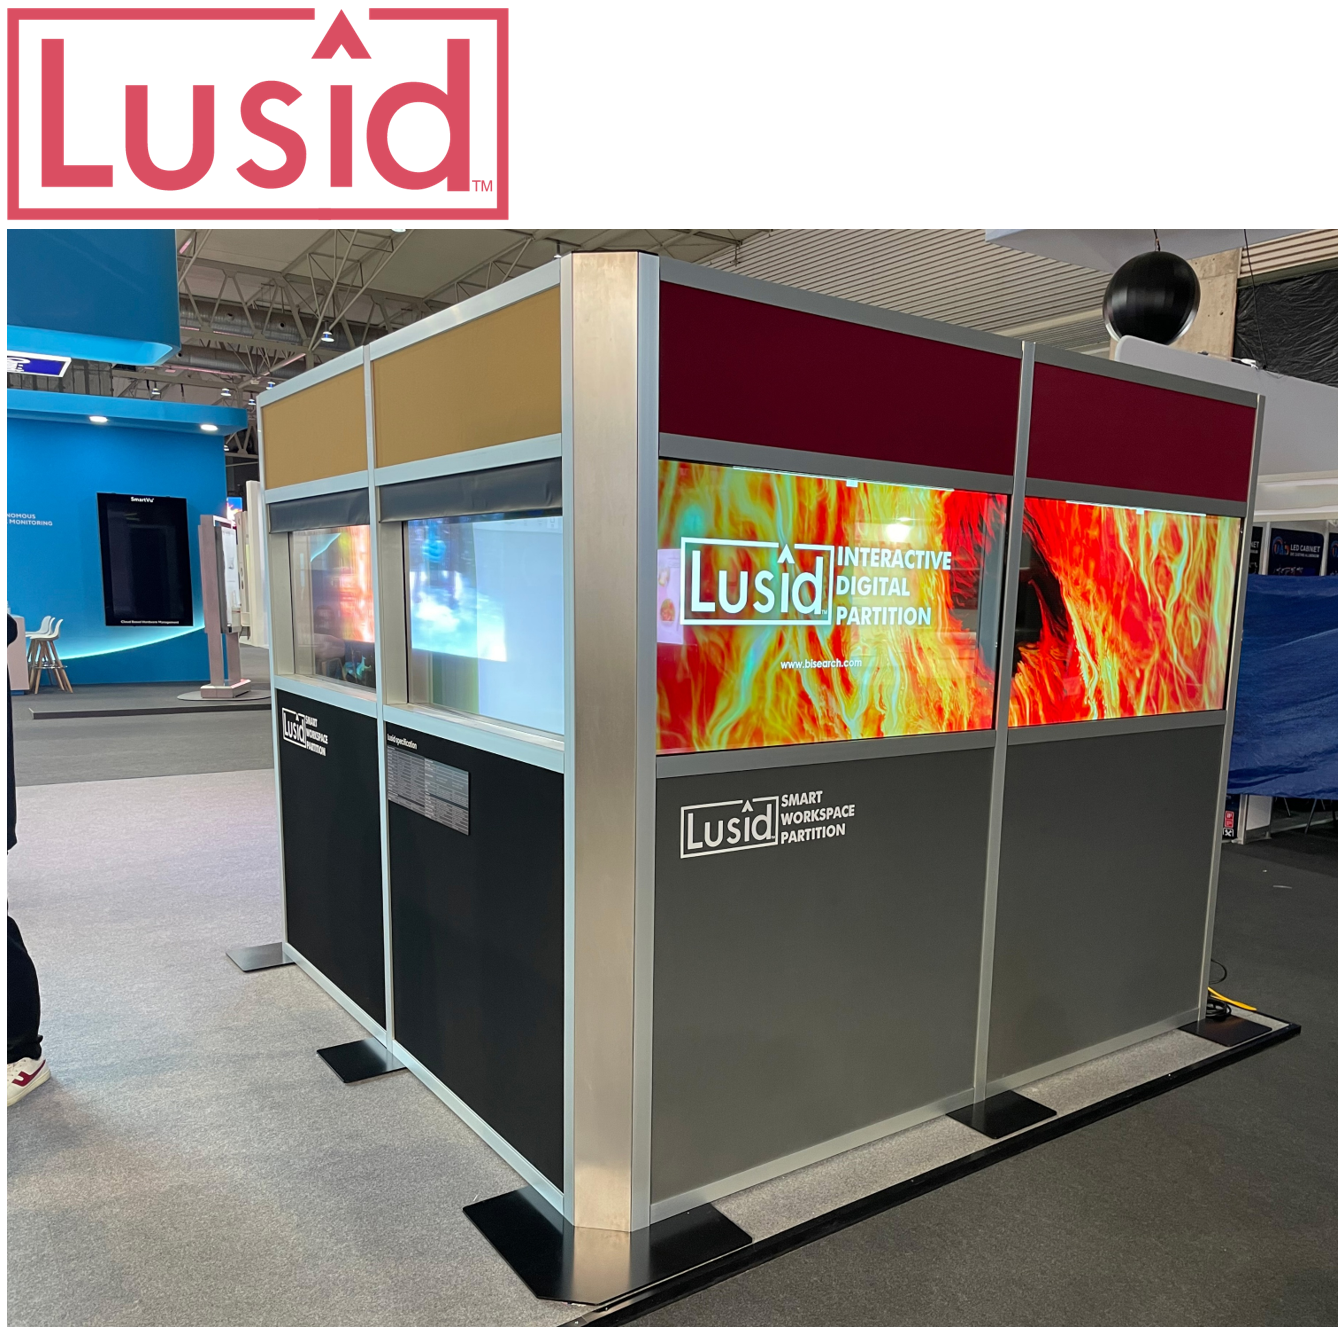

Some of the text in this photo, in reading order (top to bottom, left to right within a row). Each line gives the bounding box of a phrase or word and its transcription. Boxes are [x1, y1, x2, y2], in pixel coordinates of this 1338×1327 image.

[836, 546, 952, 571] INTERACTIVE
[691, 544, 824, 615] Lusid
[836, 575, 910, 597] DIGITAL
[836, 606, 932, 626] PARTITION
[780, 657, 862, 670] www.bisearch.com
[283, 712, 305, 744] Lusid
[781, 790, 823, 807] SMART
[687, 799, 772, 850] Lusid
[780, 804, 856, 826] WORKSPACE
[780, 823, 846, 845] PARTITION
